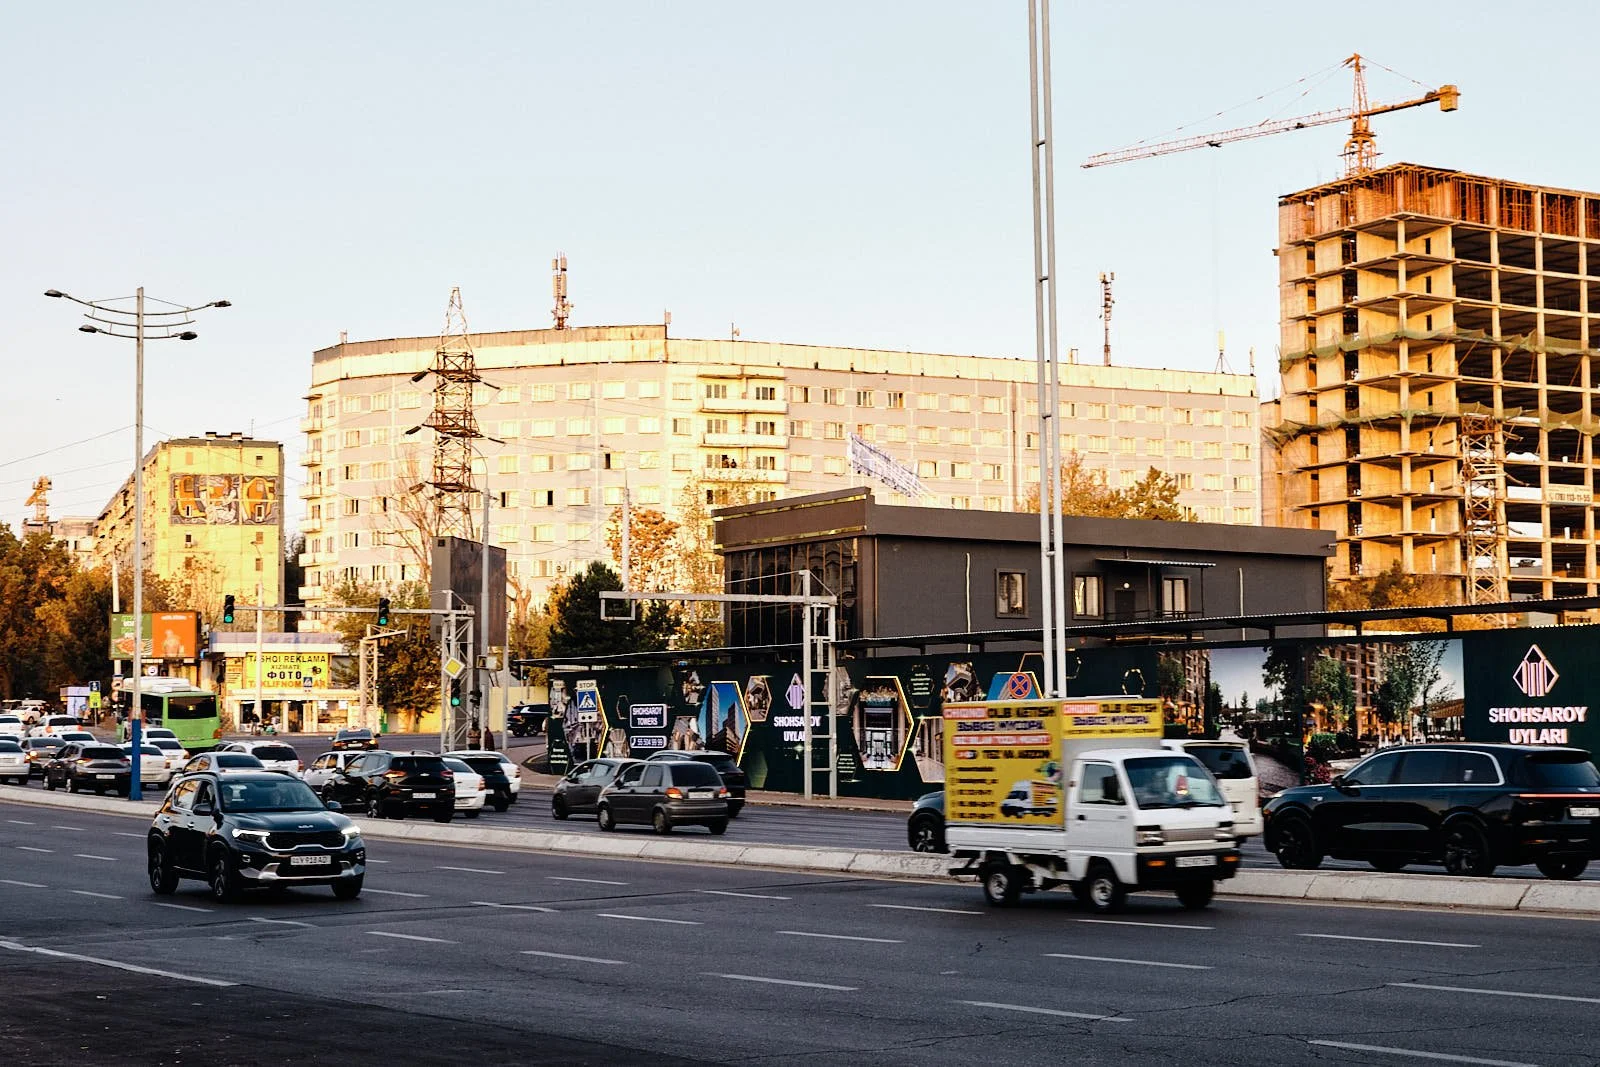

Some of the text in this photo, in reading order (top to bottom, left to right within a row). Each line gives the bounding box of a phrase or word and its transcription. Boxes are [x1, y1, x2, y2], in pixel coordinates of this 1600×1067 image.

[267, 671, 302, 680] ФОТО
[632, 706, 662, 716] SHOHSAROY
[1488, 706, 1588, 722] SHOHSAROY
[637, 717, 658, 726] TOWERS
[774, 716, 822, 727] SHOHSAOY
[1509, 728, 1568, 744] UYLARI
